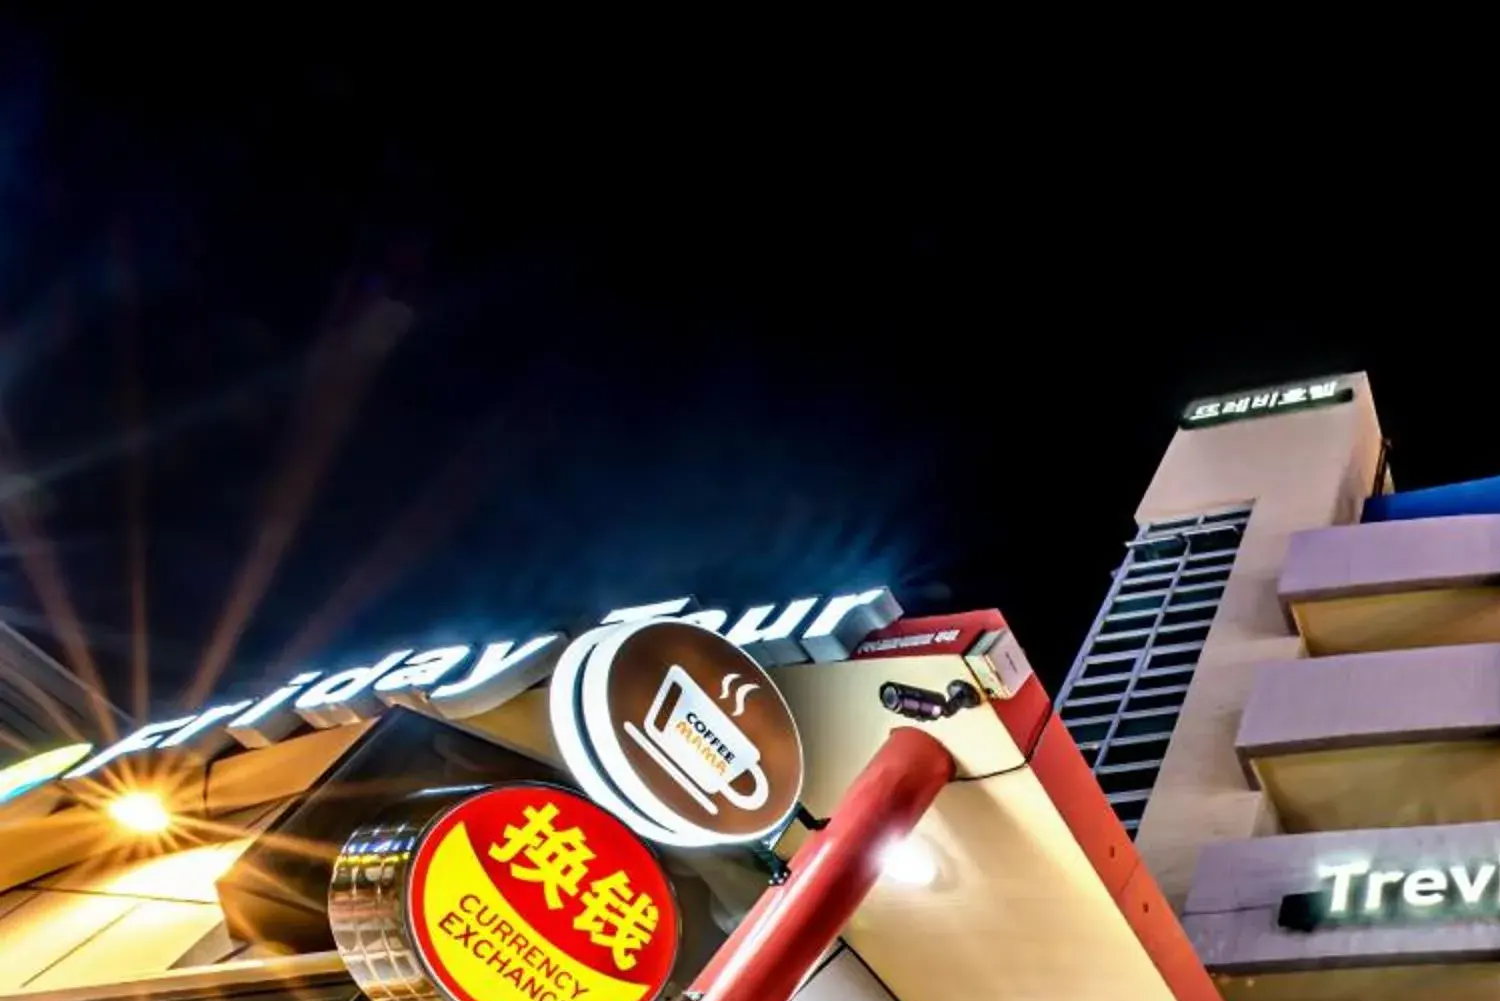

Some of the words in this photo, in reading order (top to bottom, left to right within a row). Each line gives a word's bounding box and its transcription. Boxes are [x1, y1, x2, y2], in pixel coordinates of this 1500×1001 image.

[61, 634, 561, 780] Friday
[685, 711, 736, 765] COFFEE
[458, 893, 591, 1000] CURRENCY
[487, 802, 660, 972] 换钱
